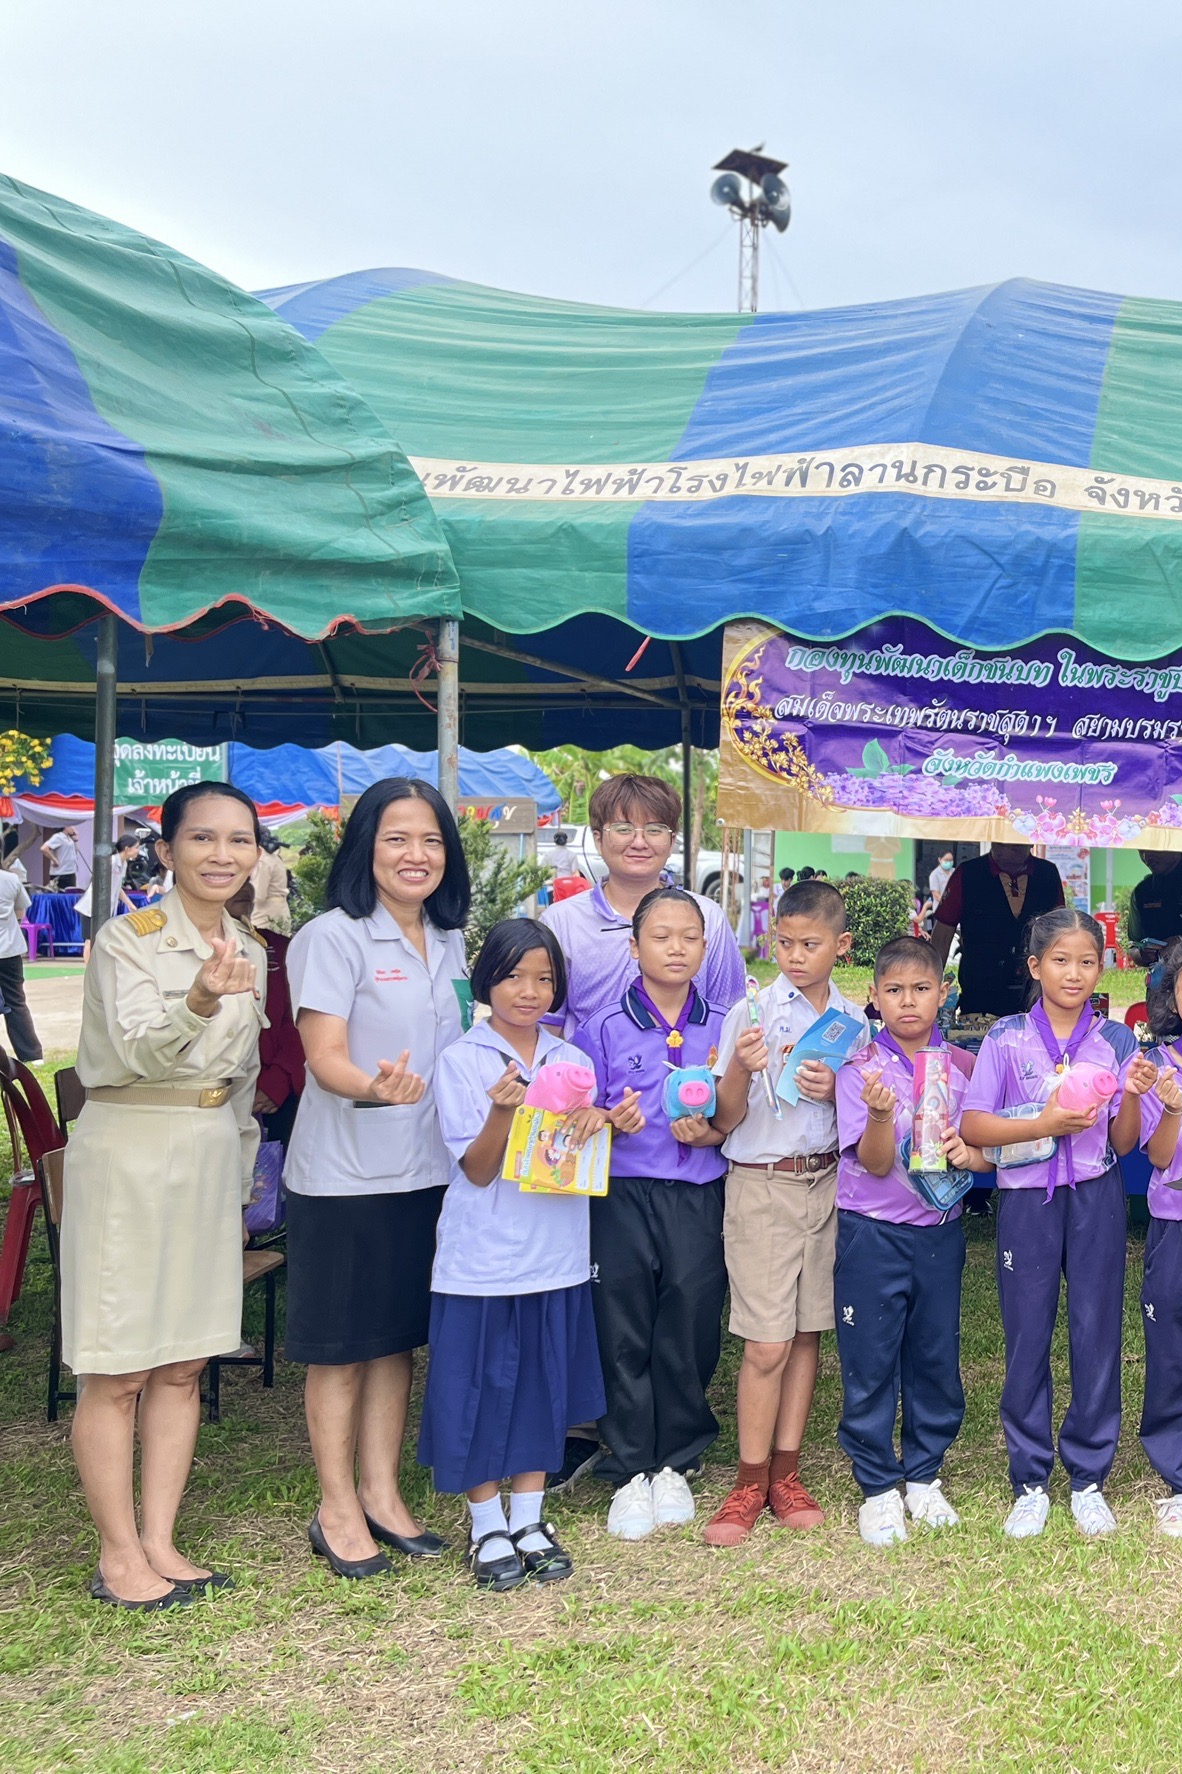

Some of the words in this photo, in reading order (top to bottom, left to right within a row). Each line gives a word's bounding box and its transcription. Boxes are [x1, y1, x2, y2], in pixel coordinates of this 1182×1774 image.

[785, 643, 1054, 687] กองทุนพัฒนาเด็กชนบท
[114, 741, 220, 767] จุดลงทะเบยน
[922, 748, 1118, 785] จังหวัดกำแพงเพชร
